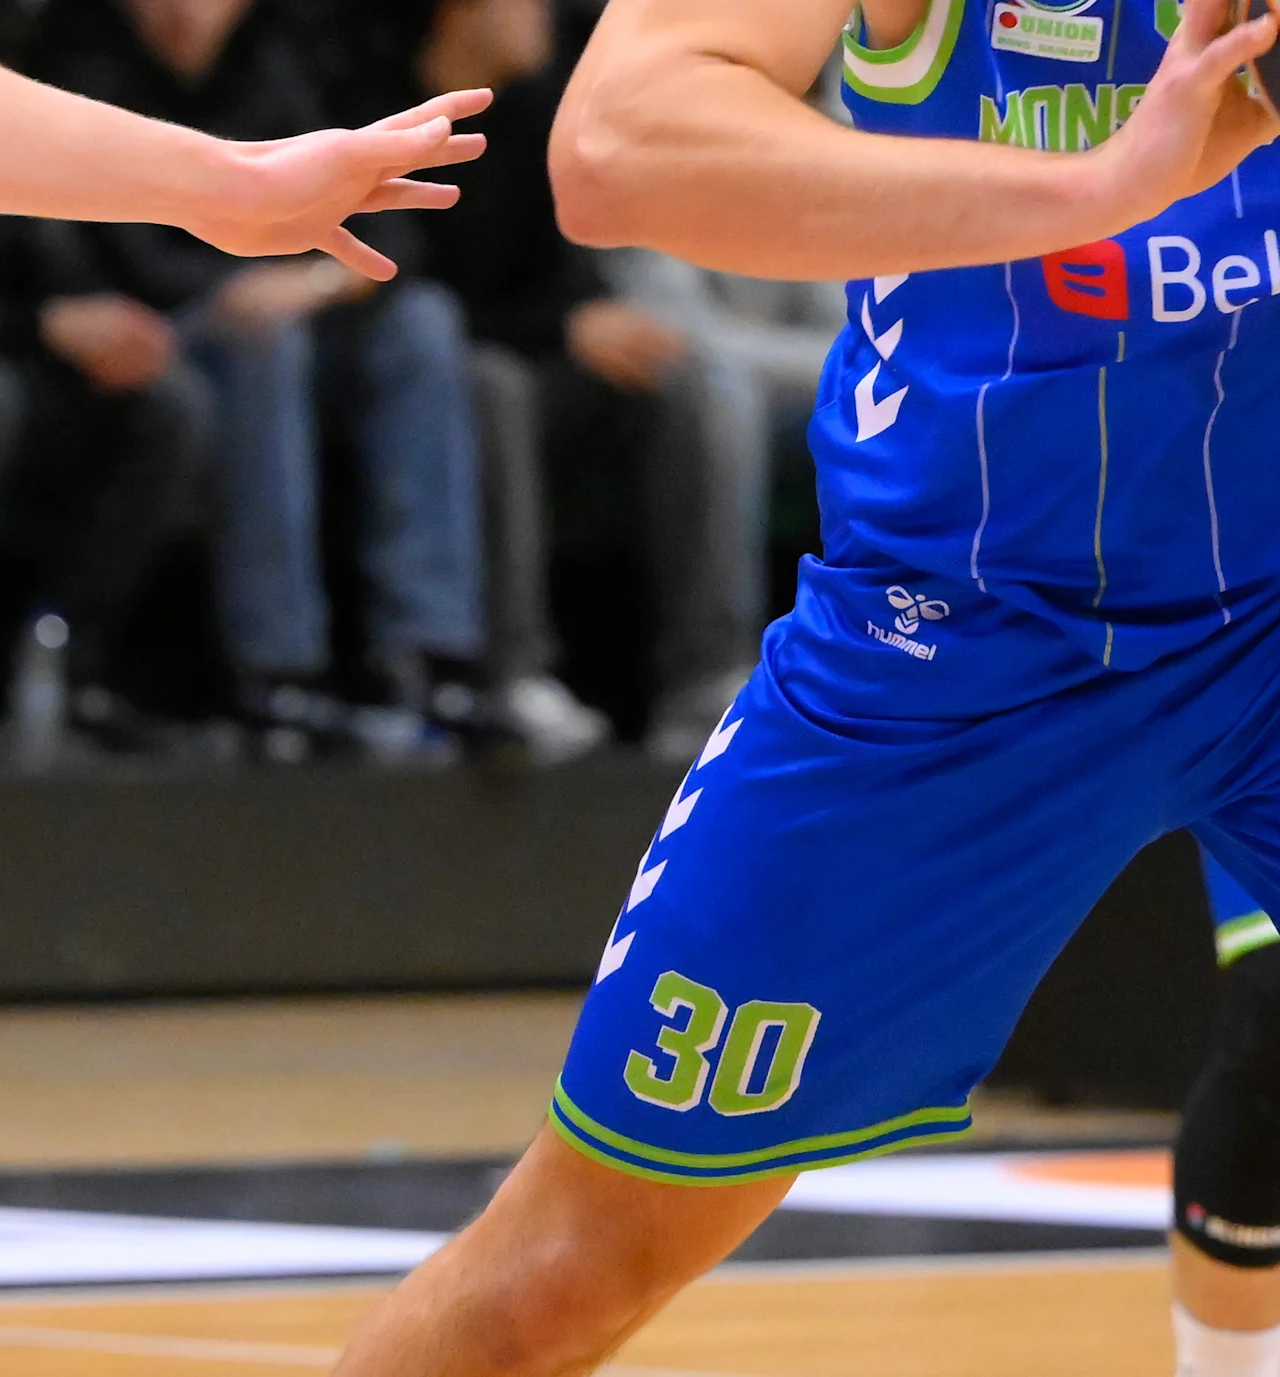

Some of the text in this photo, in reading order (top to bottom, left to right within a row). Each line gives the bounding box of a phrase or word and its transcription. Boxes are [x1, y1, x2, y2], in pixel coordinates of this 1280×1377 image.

[1021, 14, 1097, 41] UNION
[867, 620, 937, 661] hummel
[623, 969, 823, 1117] 30
